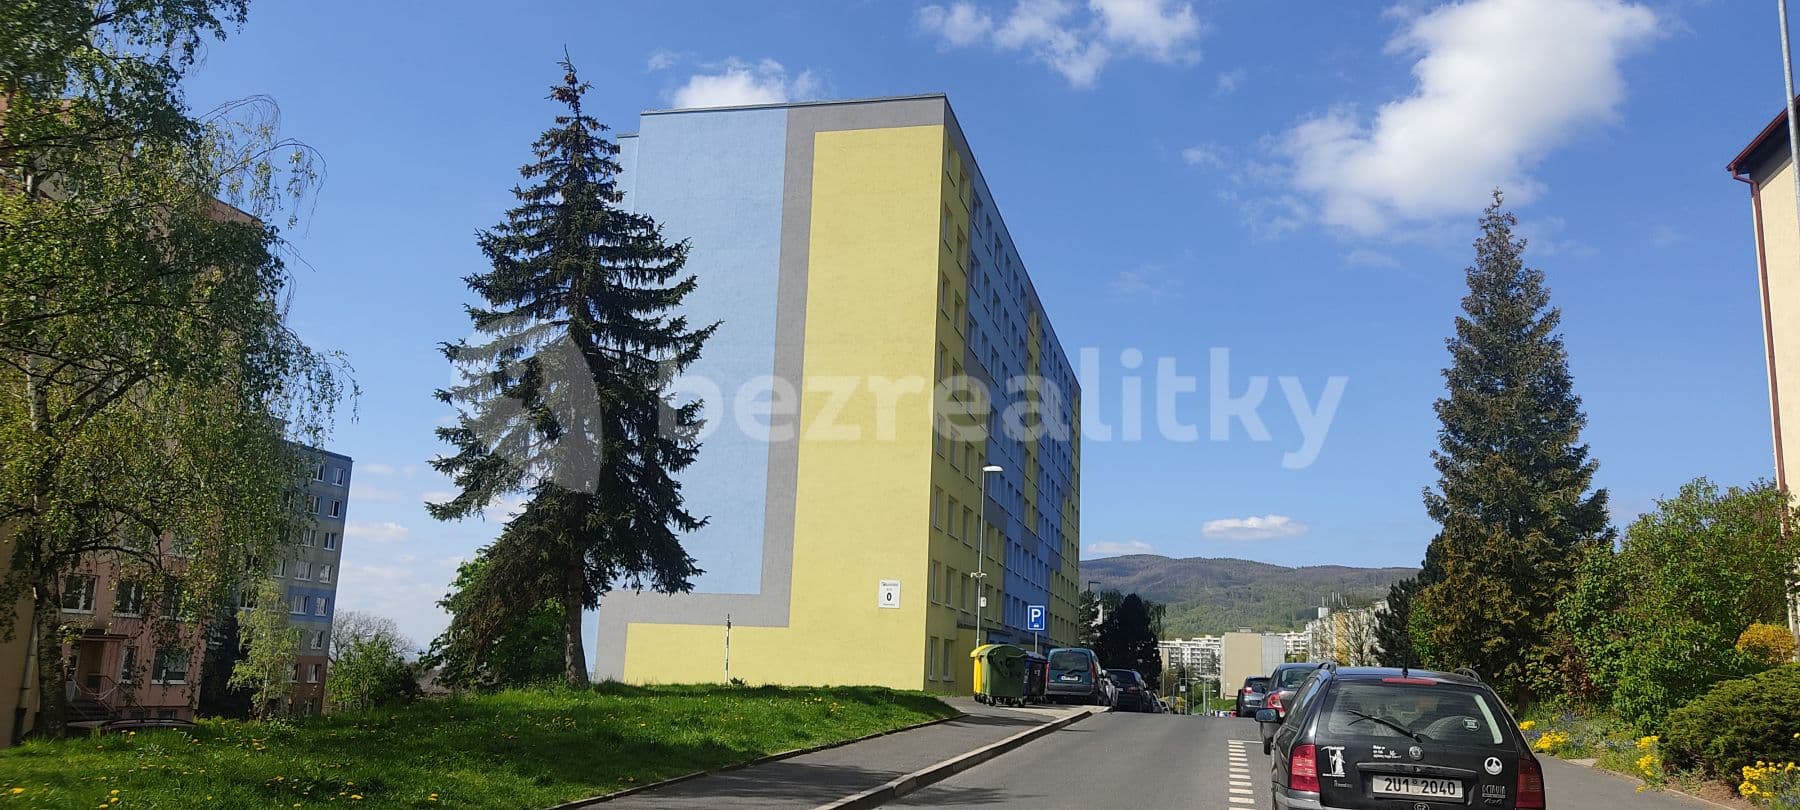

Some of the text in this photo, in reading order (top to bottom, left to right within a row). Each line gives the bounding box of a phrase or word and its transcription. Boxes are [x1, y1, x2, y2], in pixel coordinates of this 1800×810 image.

[1031, 608, 1041, 622] P
[1384, 777, 1456, 796] 2U1 2040
